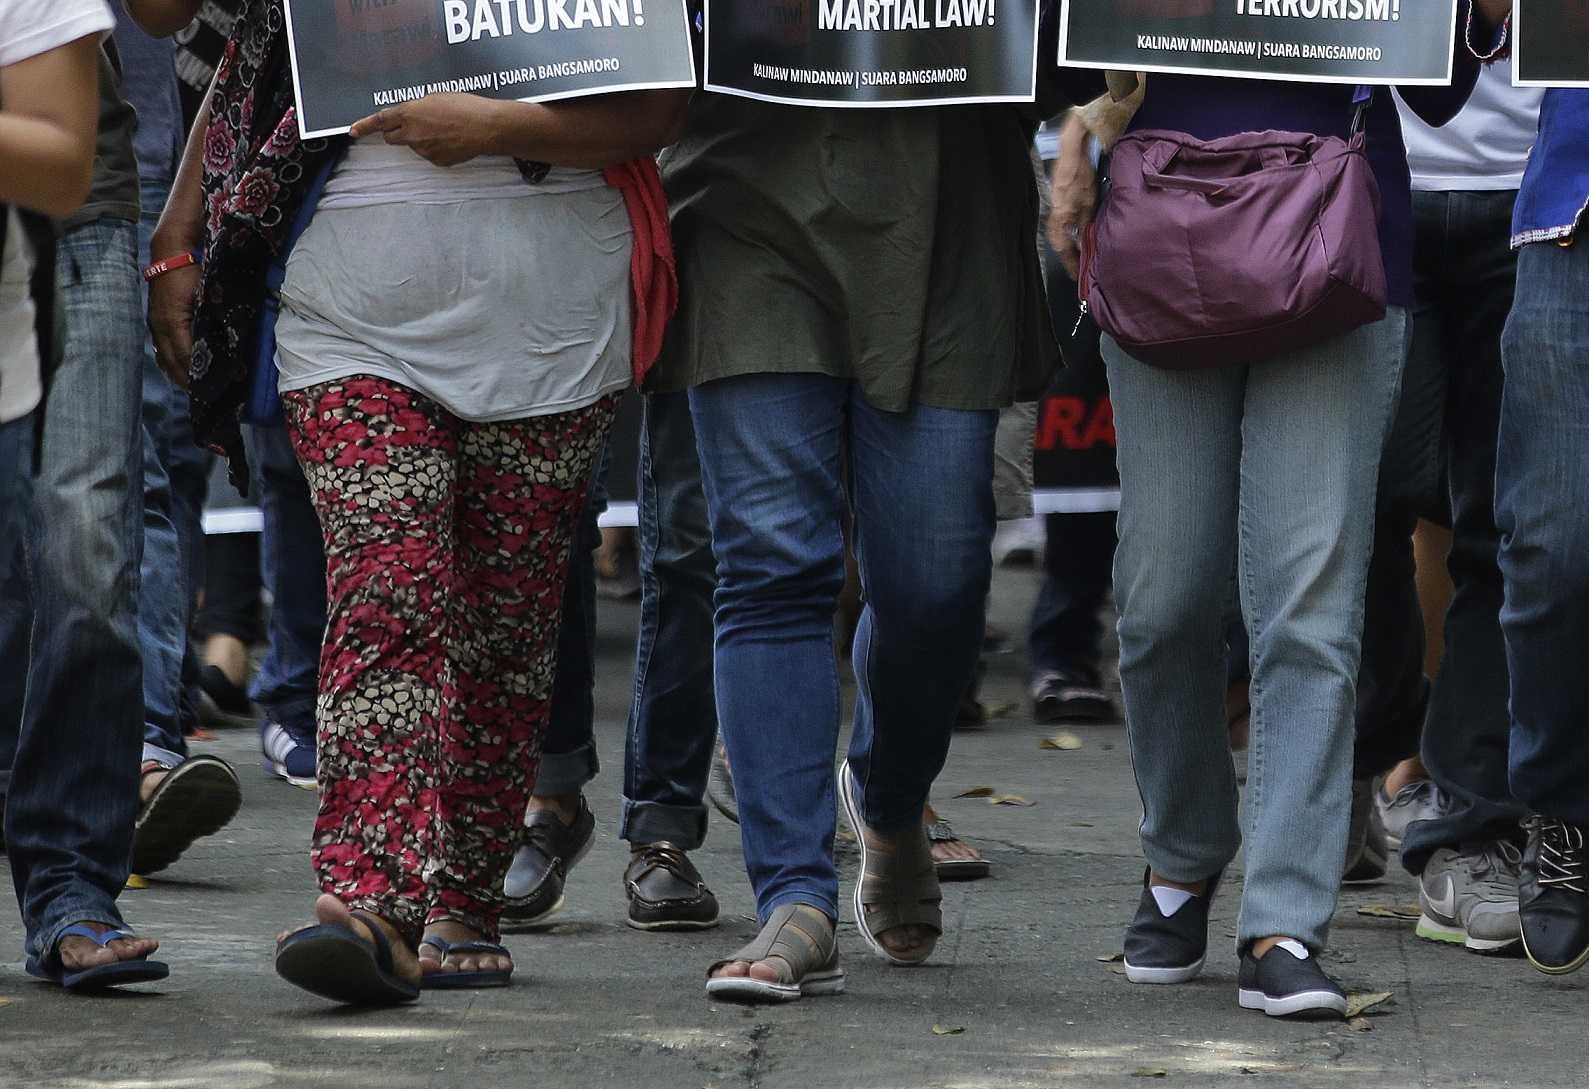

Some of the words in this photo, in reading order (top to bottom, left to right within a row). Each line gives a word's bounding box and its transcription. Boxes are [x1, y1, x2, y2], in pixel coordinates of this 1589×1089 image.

[1136, 34, 1189, 51] KALINAW
[1190, 38, 1256, 56] MINDANAW
[1263, 42, 1300, 58] SUARA
[1302, 44, 1382, 61] BANGSAMORO
[373, 85, 425, 107] KALINAW
[427, 71, 492, 97] MINDANAW
[499, 66, 537, 86] SUARA
[538, 57, 620, 80] BANGSAMORO
[753, 62, 788, 82] KALINAW
[790, 68, 854, 85] MINDANAW
[861, 71, 898, 86] SUARA
[899, 66, 967, 85] BANGSAMORO
